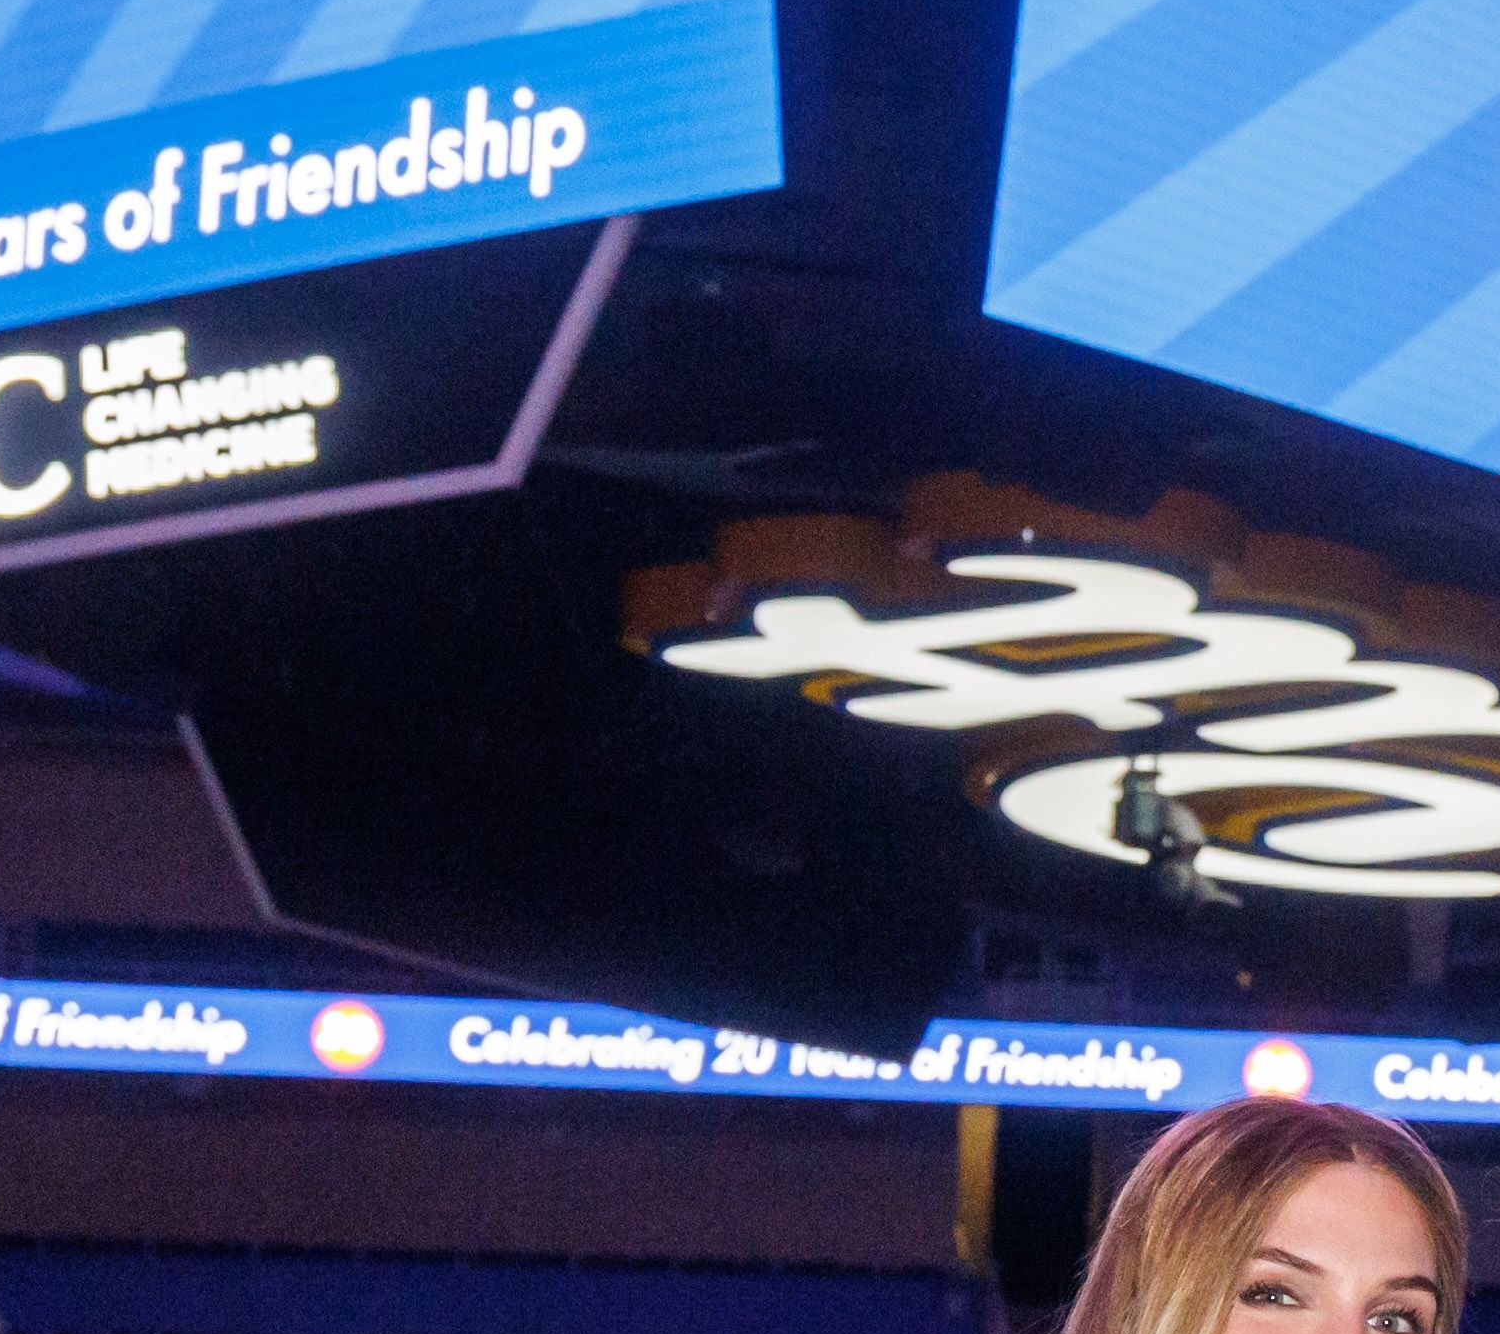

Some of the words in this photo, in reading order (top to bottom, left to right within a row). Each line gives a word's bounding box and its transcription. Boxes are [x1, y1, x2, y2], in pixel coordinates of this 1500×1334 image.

[105, 147, 186, 252] of
[199, 86, 587, 237] Friendship
[79, 327, 187, 394] LIFE
[83, 354, 340, 445] CHANGING
[14, 996, 248, 1065] Friendship
[449, 1013, 704, 1084] Celebrating
[910, 1033, 962, 1082] of
[963, 1038, 1181, 1102] Friendship
